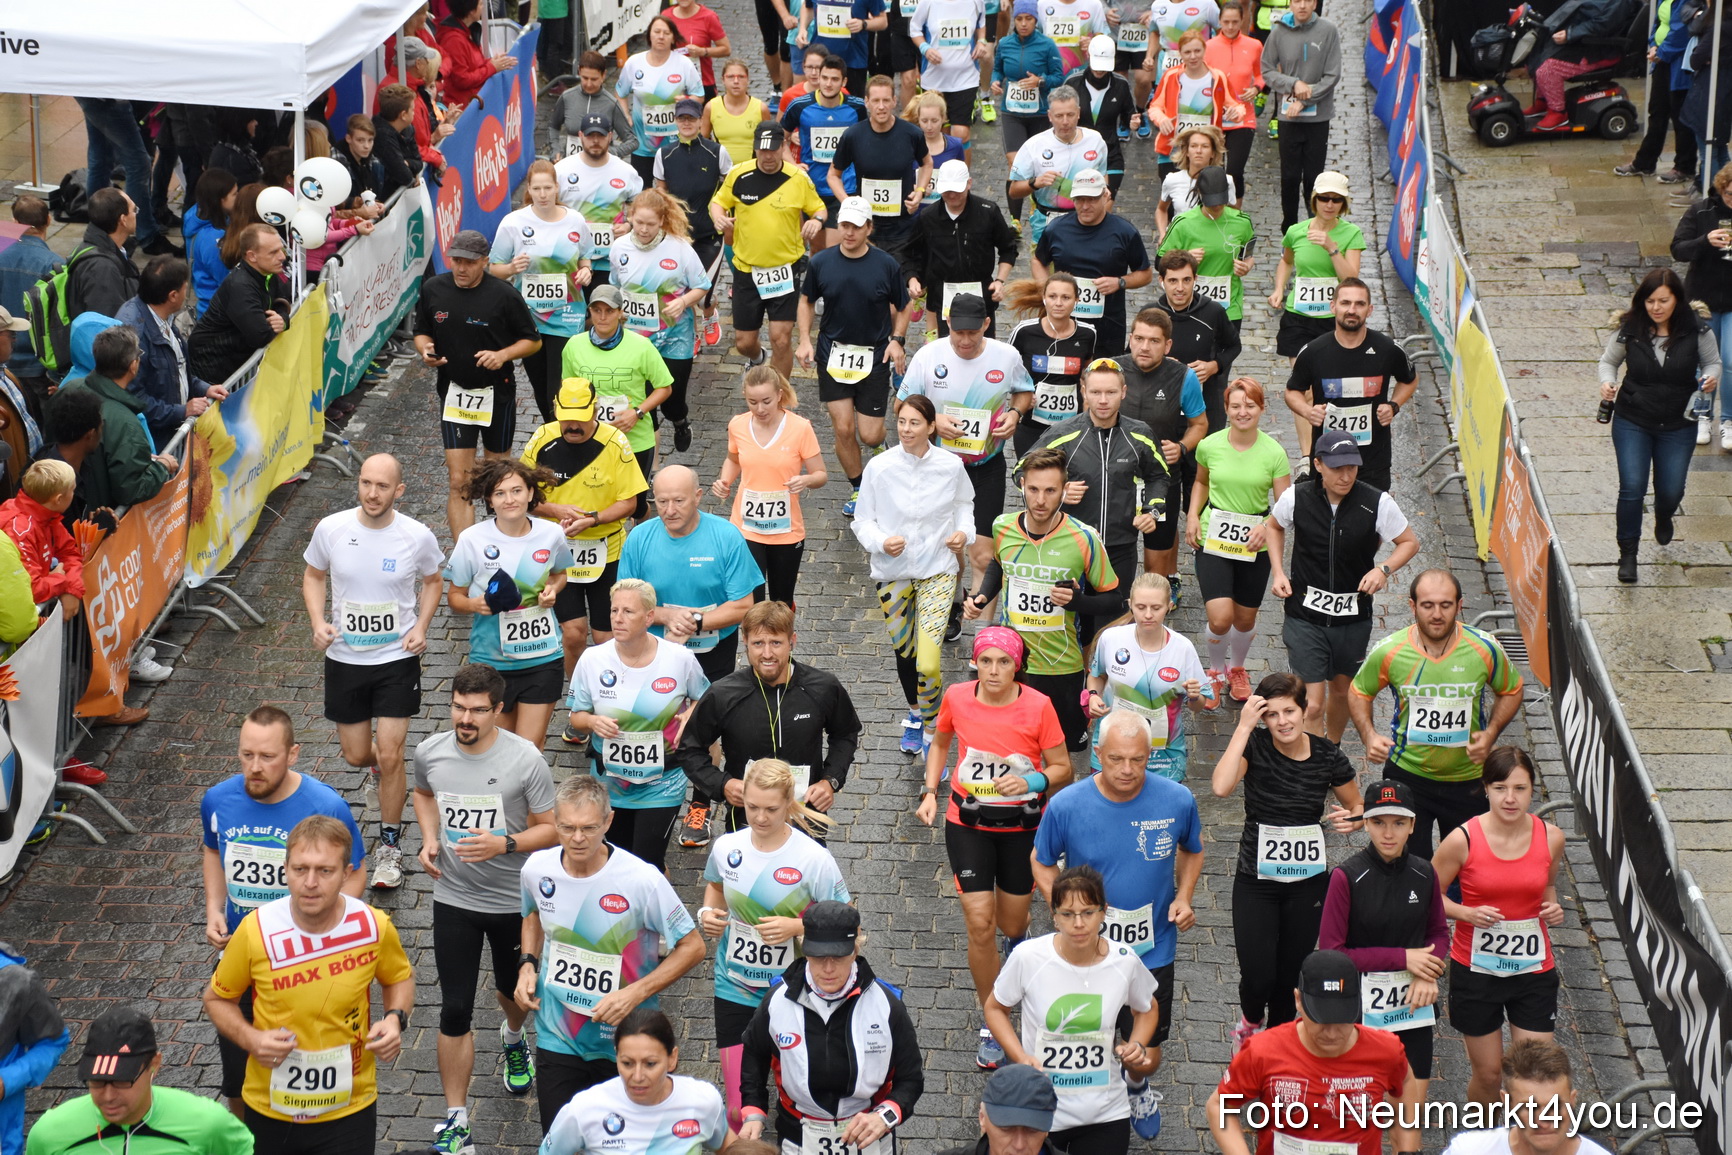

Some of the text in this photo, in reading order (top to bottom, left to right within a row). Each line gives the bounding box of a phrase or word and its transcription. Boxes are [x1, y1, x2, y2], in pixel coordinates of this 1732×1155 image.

[827, 14, 841, 26] 54
[941, 26, 968, 38] 2111
[1053, 23, 1074, 35] 279
[1121, 29, 1147, 41] 2026
[1010, 88, 1036, 101] 2505
[646, 112, 675, 125] 2400
[873, 189, 890, 203] 53
[757, 266, 789, 286] 2130
[526, 283, 564, 299] 2055
[765, 285, 783, 293] Robert
[1300, 286, 1335, 301] 2119
[536, 301, 554, 309] Ingrid
[622, 299, 656, 317] 2054
[838, 352, 865, 370] 114
[456, 393, 484, 410] 177
[1038, 394, 1075, 411] 2399
[458, 411, 478, 420] Stefan
[954, 419, 981, 438] 24
[1328, 415, 1368, 432] 2478
[953, 439, 972, 448] Franz
[745, 500, 787, 518] 2473
[1218, 522, 1251, 543] 253
[1218, 543, 1243, 554] Andrea
[571, 569, 591, 577] Heinz
[1001, 560, 1071, 582] BOCK
[1018, 592, 1054, 614] 358
[1310, 590, 1353, 613] 2264
[346, 613, 395, 633] 3050
[1022, 615, 1047, 626] Marco
[506, 616, 551, 642] 2863
[350, 634, 390, 645] Stefan
[513, 641, 548, 653] Elisabeth
[655, 680, 674, 690] Hervis
[1400, 681, 1479, 700] BOCK
[1415, 707, 1467, 730] 2844
[1427, 734, 1453, 743] Samir
[609, 742, 659, 765] 2664
[622, 768, 644, 778] Petra
[971, 761, 1011, 781] 212
[445, 807, 498, 830] 2277
[224, 824, 250, 839] Wyk
[253, 825, 273, 835] auf
[1265, 839, 1320, 862] 2305
[232, 859, 288, 887] 2336
[777, 869, 800, 882] Hervis
[1276, 866, 1308, 876] Kathrin
[237, 887, 285, 900] Alexander
[603, 896, 627, 909] Hervis
[733, 936, 788, 967] 2367
[1480, 931, 1540, 957] 2220
[272, 950, 379, 992] MAX BÖGL
[1496, 960, 1520, 971] Julia
[553, 958, 614, 994] 2366
[743, 967, 774, 980] Kristin
[566, 991, 593, 1008] Heinz
[1383, 1010, 1414, 1025] Sandra
[1043, 1045, 1105, 1070] 2233
[286, 1065, 338, 1091] 290
[1052, 1074, 1093, 1086] Cornelia
[1275, 1080, 1302, 1089] IMMER
[1331, 1076, 1374, 1084] NEUMARKTER
[1274, 1087, 1302, 1095] WIEDER
[1330, 1083, 1367, 1091] STADTLAUF
[283, 1094, 337, 1109] Siegmund
